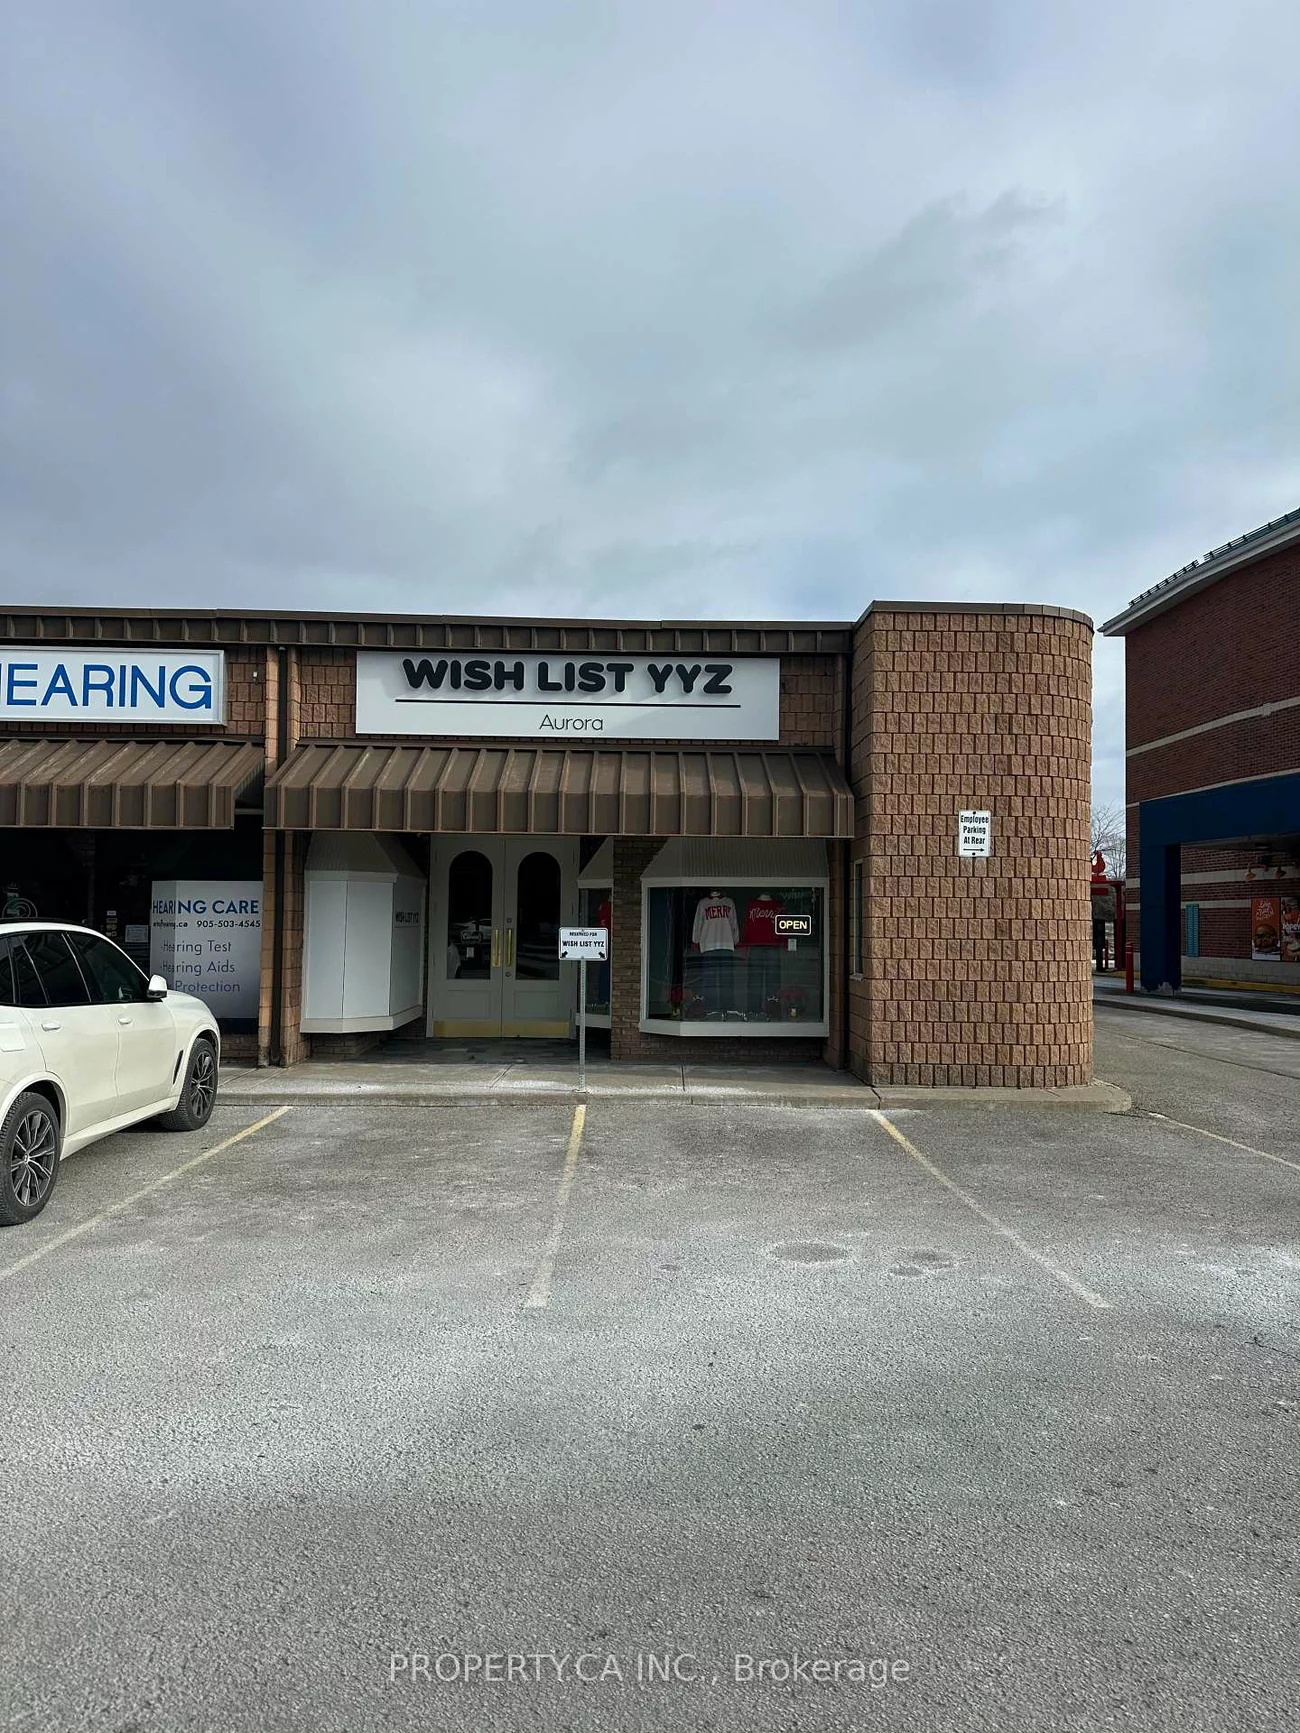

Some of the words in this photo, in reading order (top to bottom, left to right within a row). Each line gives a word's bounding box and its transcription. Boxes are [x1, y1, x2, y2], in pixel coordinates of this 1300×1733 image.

[402, 658, 525, 691] WISH
[537, 661, 634, 693] LIST
[647, 663, 733, 694] YYZ
[0, 663, 212, 709] EARING
[539, 714, 604, 731] Aurora
[960, 815, 989, 824] Employee
[963, 825, 986, 835] Parking
[963, 836, 970, 844] At
[971, 836, 985, 844] Rear
[152, 900, 207, 914] HEARING
[212, 900, 259, 914] CARE
[748, 907, 779, 924] Merr
[196, 920, 261, 928] 905-503-4545
[779, 920, 808, 930] OPEN
[163, 941, 203, 956] Hearing
[207, 940, 232, 952] Test
[162, 961, 202, 976] Hearing
[207, 959, 235, 973] Aids
[175, 981, 240, 992] Protection
